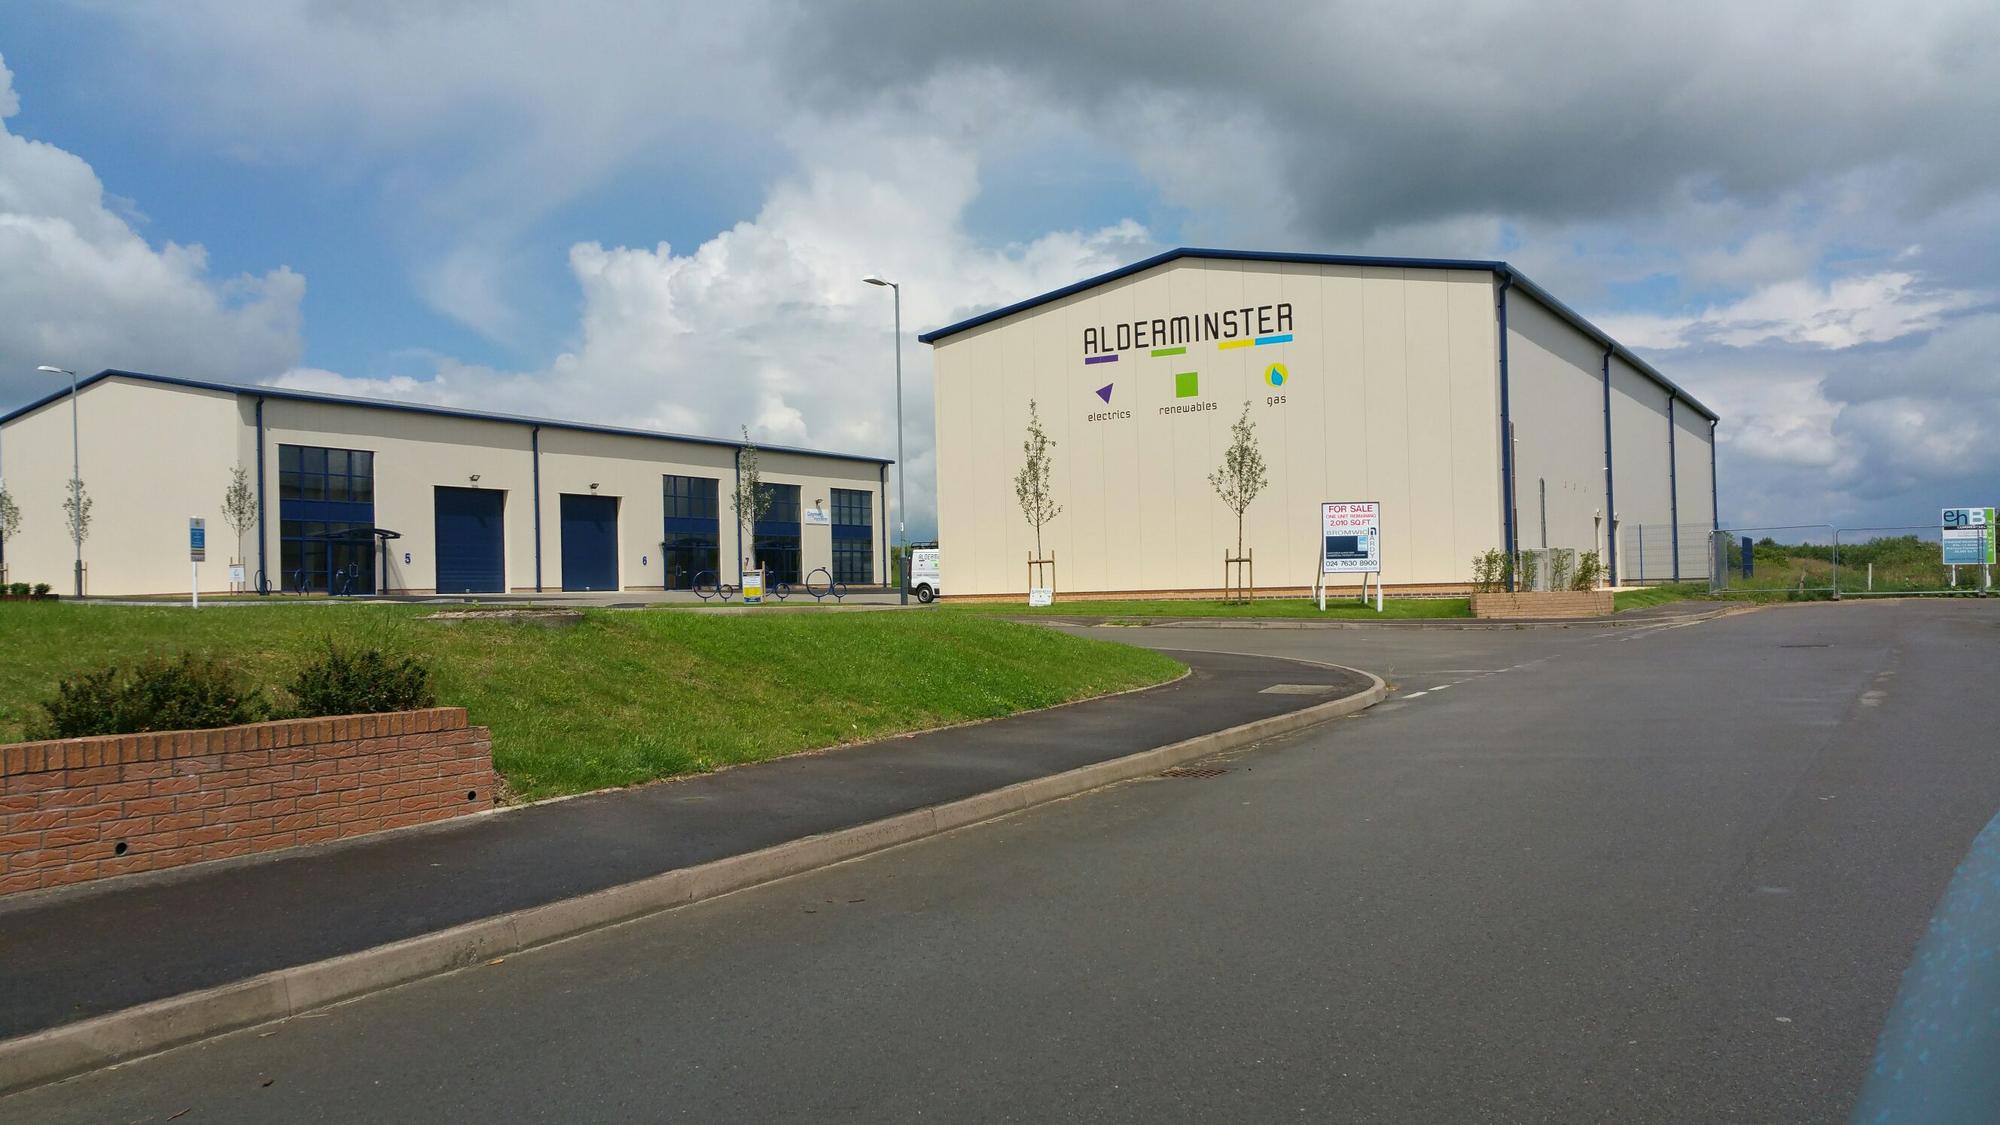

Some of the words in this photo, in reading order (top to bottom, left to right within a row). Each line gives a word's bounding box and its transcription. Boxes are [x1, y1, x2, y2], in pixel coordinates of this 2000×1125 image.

[1084, 303, 1293, 355] ALDERMINSTER
[1266, 394, 1287, 407] gas
[1159, 401, 1217, 416] renewables
[1087, 409, 1131, 422] electrics
[1328, 505, 1347, 513] FOR
[1350, 504, 1373, 512] SALE
[1330, 519, 1348, 527] 2,010
[405, 552, 411, 564] 5
[642, 555, 648, 566] 6
[1359, 559, 1378, 567] 8900
